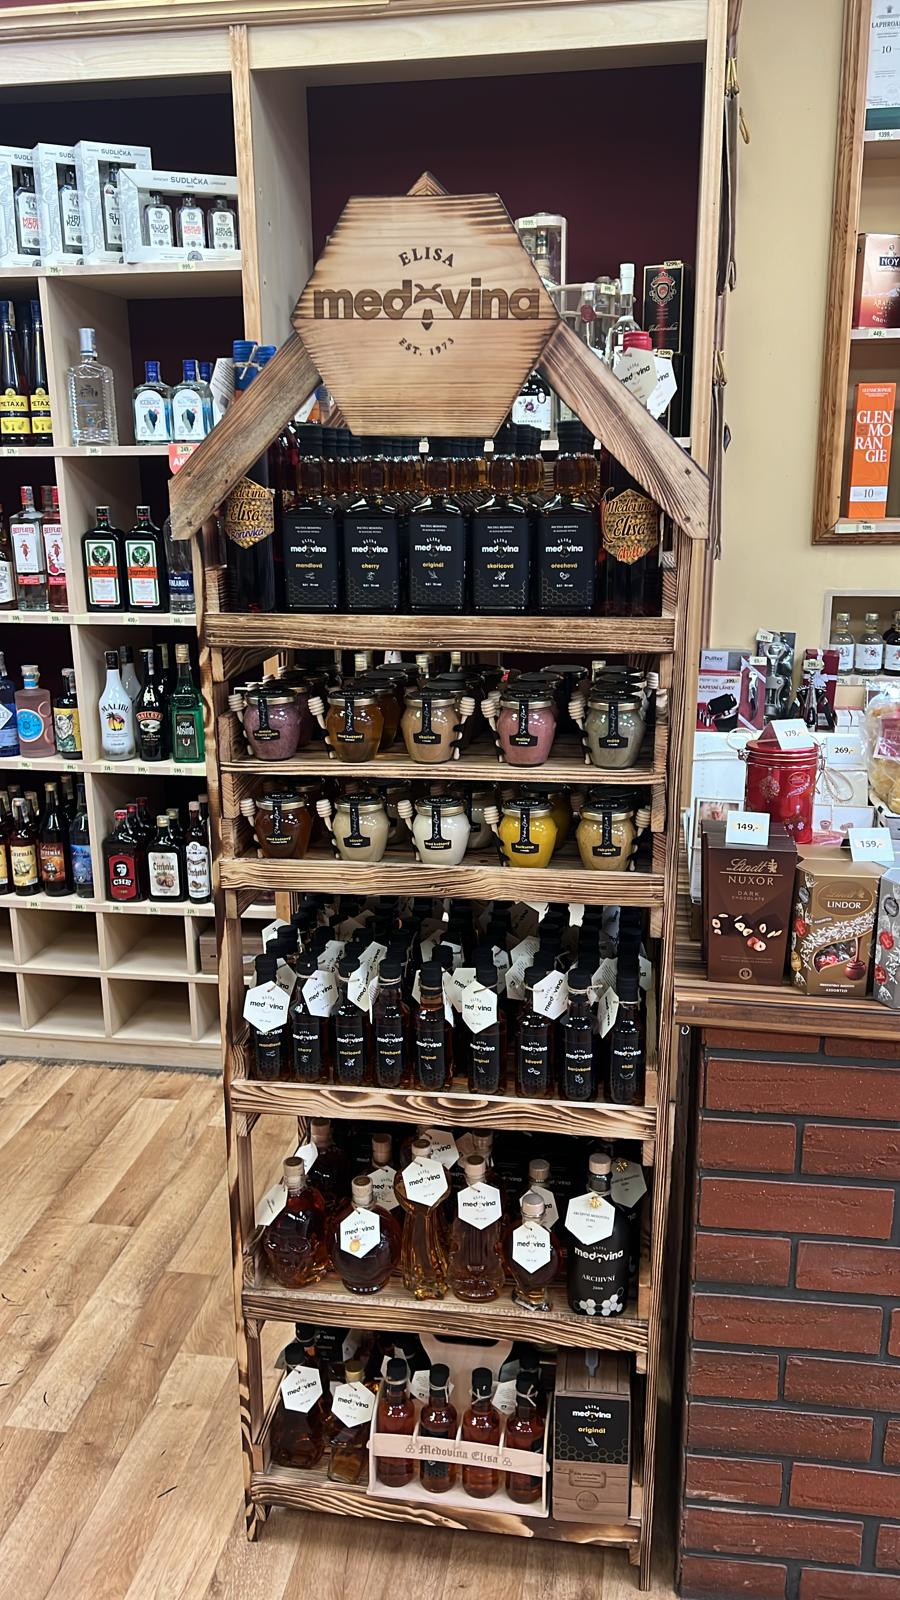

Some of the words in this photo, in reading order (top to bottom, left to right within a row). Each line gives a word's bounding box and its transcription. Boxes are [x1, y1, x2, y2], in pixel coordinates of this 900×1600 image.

[882, 46, 892, 54] 10
[170, 176, 208, 186] SUDLIČKA
[398, 247, 454, 268] ELISA
[881, 257, 900, 266] NOY
[398, 338, 422, 356] EST.
[430, 338, 454, 356] 1973
[856, 410, 893, 424] GLEN
[868, 424, 893, 437] MO
[854, 436, 883, 450] RAN
[866, 450, 888, 463] GIE
[864, 490, 874, 498] 10
[230, 500, 260, 521] Elisa
[614, 516, 646, 536] Elisa
[737, 822, 759, 832] 149,-
[860, 840, 882, 848] 159,-
[726, 858, 768, 873] Lindt
[728, 876, 774, 886] NUXOR
[827, 900, 862, 909] LINDOR
[581, 1274, 615, 1283] ARCHIVNÍ
[418, 1444, 468, 1459] Medovina
[471, 1451, 498, 1463] Elisa
